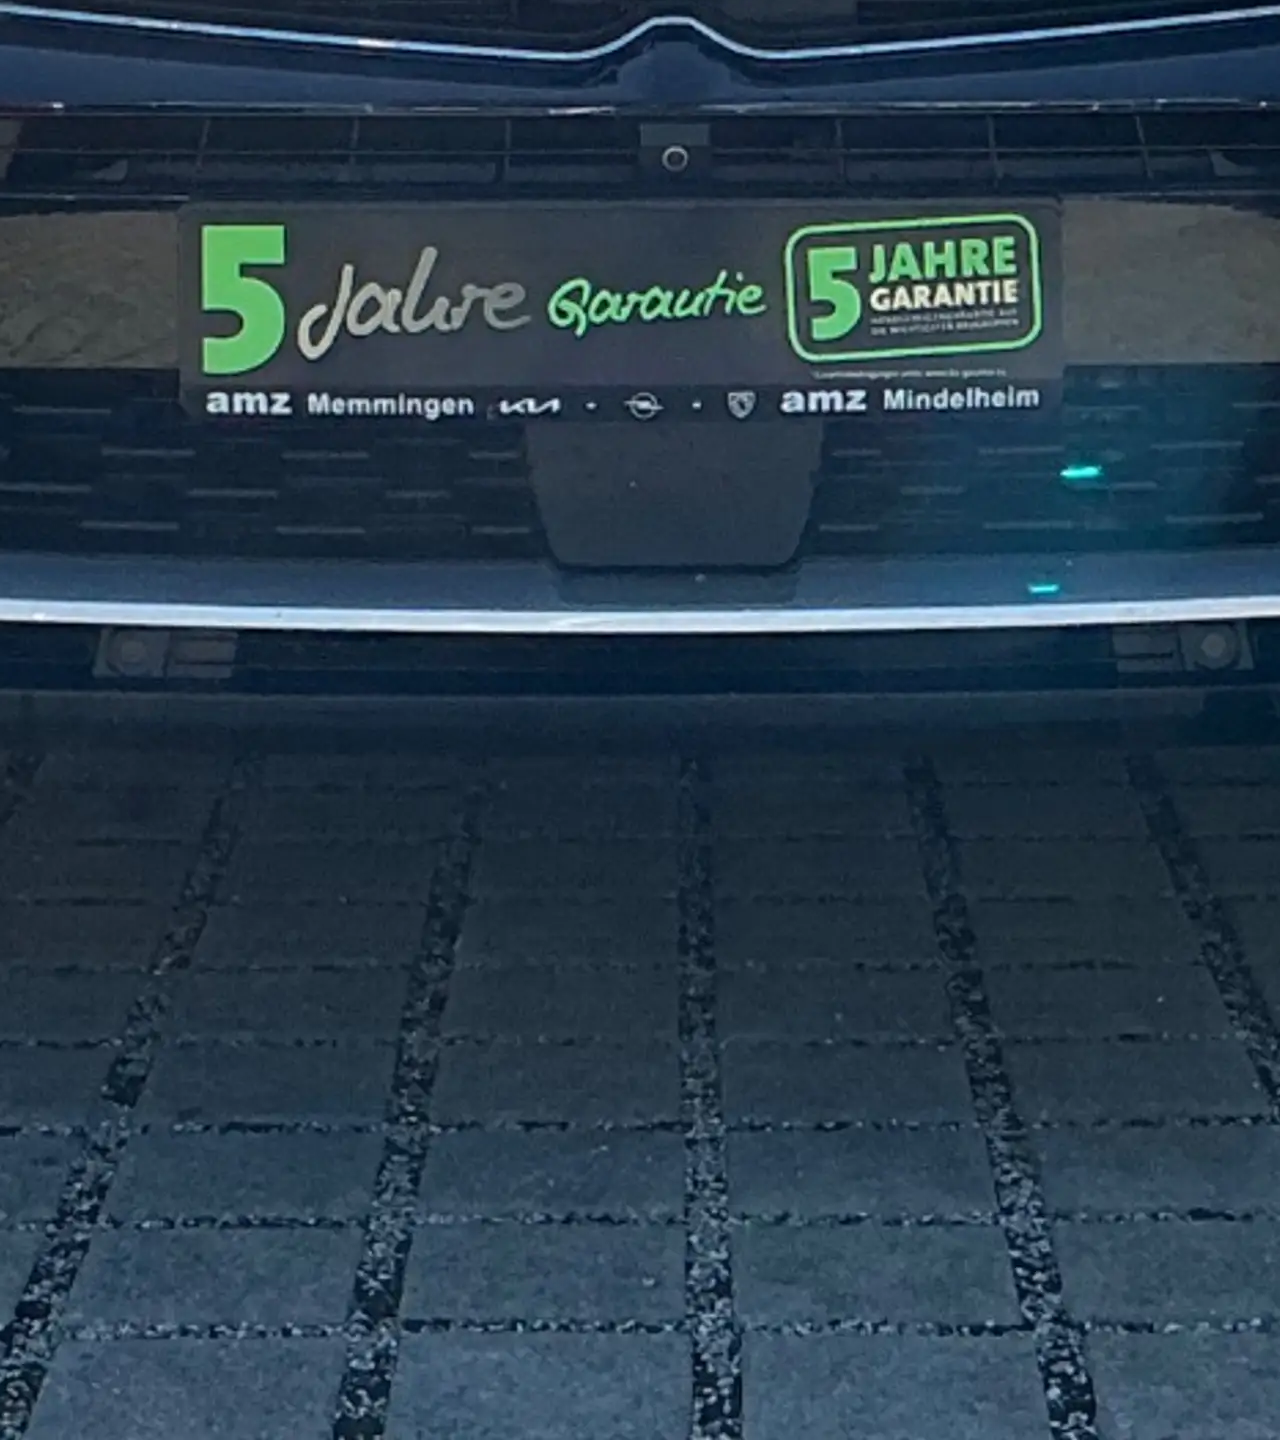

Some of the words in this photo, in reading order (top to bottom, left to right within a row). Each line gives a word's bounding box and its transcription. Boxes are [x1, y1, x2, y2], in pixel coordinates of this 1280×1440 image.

[201, 224, 286, 375] 5
[296, 245, 532, 361] Jahre
[547, 269, 767, 337] Garantie
[807, 246, 862, 342] 5
[868, 235, 1018, 284] JAHRE
[869, 279, 1019, 311] GARANTIE
[205, 391, 293, 416] amz
[306, 392, 475, 421] Memmingen
[780, 389, 868, 414] amz
[882, 385, 1041, 411] Mindelheim
